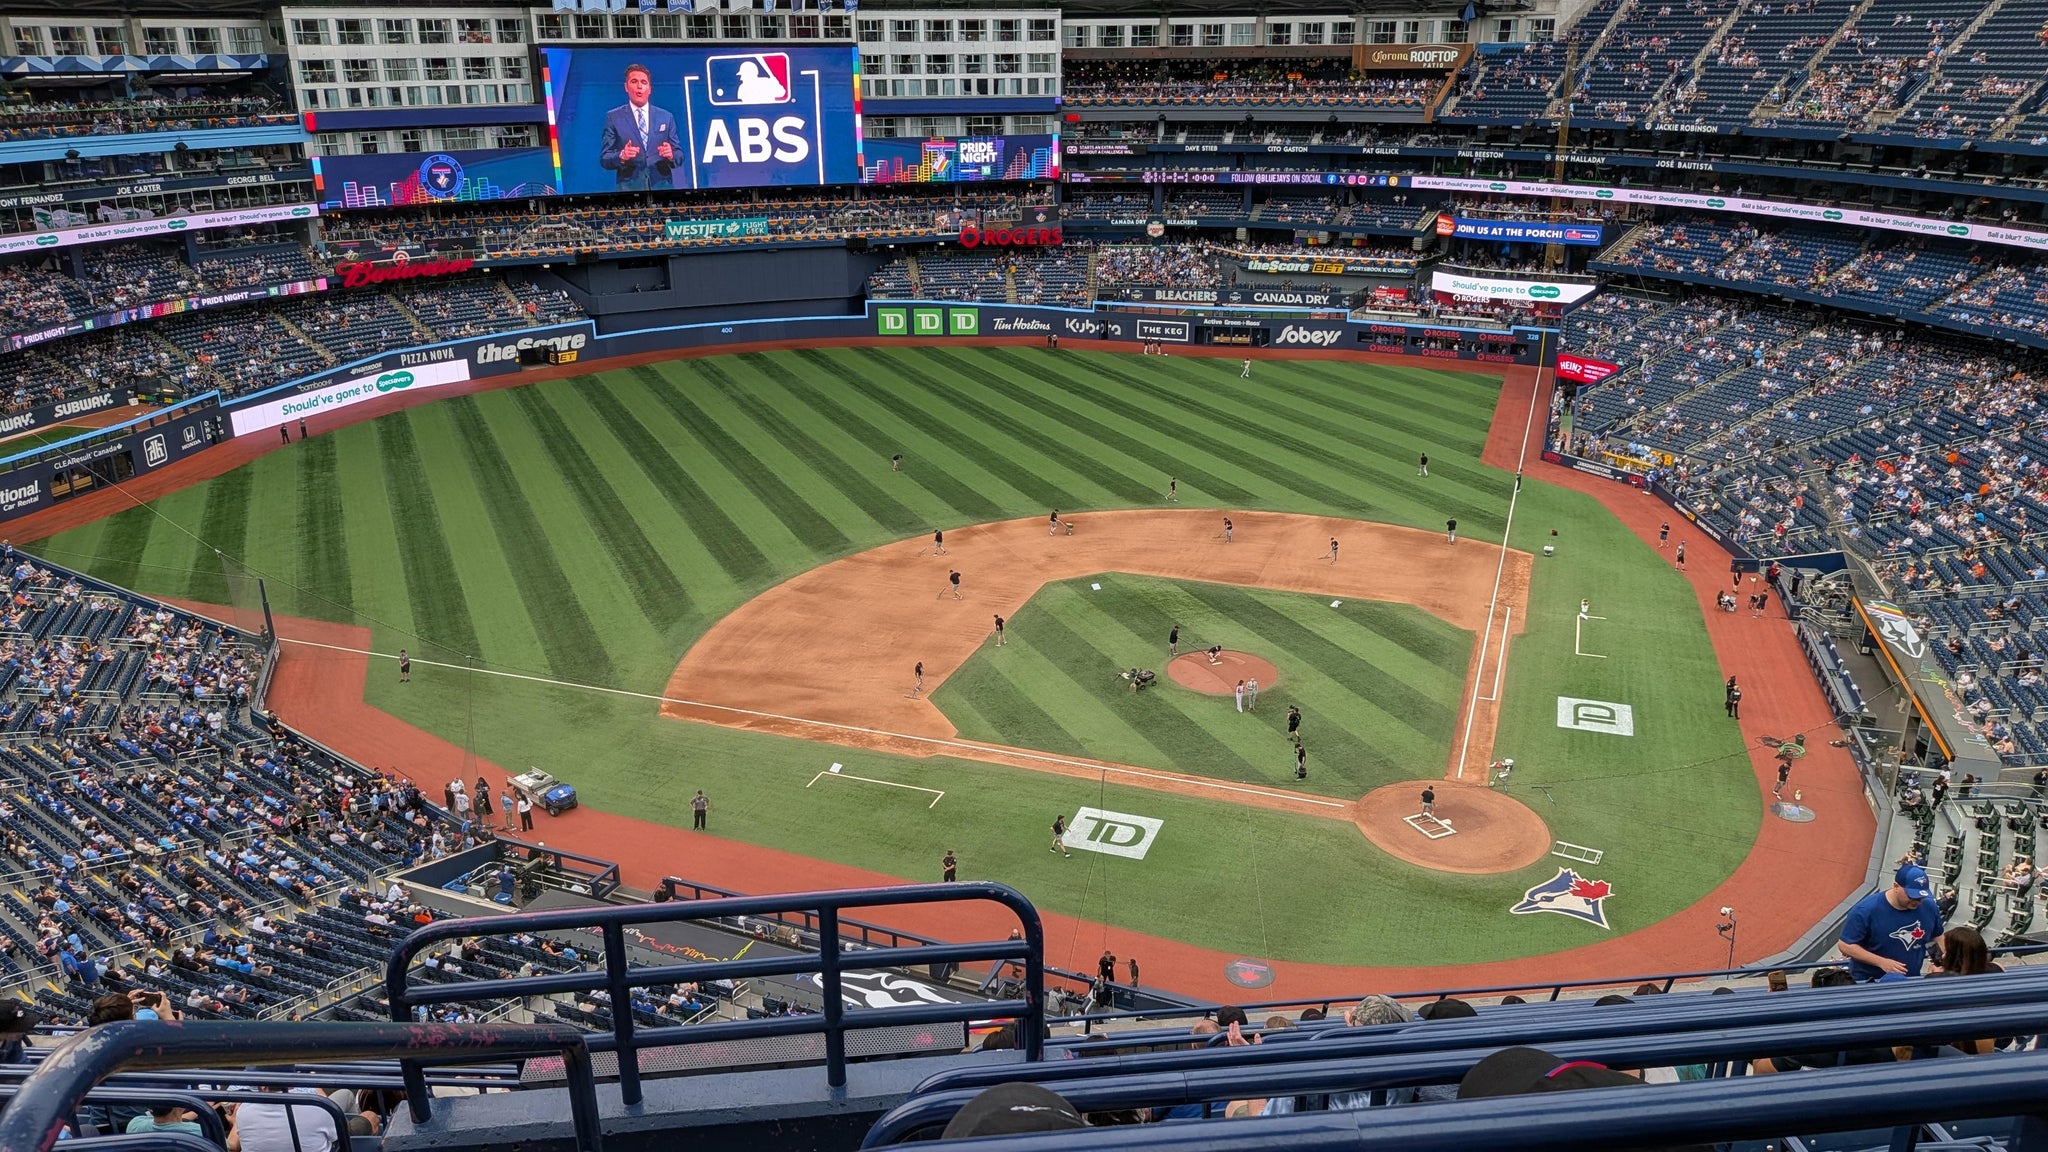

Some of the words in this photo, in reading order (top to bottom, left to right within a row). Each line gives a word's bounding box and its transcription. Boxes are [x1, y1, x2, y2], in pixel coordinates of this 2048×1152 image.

[1371, 50, 1408, 64] Corona
[1410, 51, 1458, 62] ROOFTOP
[1655, 123, 1678, 132] JACKIE
[1680, 124, 1717, 133] ROBINSON
[702, 116, 809, 164] ABS
[960, 142, 994, 153] PRIDE
[960, 152, 998, 163] NIGHT
[1458, 150, 1473, 158] PAUL
[1475, 151, 1503, 159] BEESTON
[1555, 154, 1569, 162] ROY
[1570, 156, 1606, 164] HALLADAY
[1656, 159, 1674, 168] JOSÉ
[1677, 161, 1713, 171] BAUTISTA
[227, 175, 257, 185] GEORGE
[259, 174, 275, 182] BELL
[1232, 174, 1255, 183] FOLLOW
[1255, 174, 1290, 183] @BLUEJAYS
[1292, 175, 1300, 183] ON
[1301, 175, 1322, 183] SOCIAL
[117, 187, 131, 195] JOE
[134, 184, 162, 193] CARTER
[0, 199, 17, 208] ONY
[21, 194, 64, 205] FERNANDEZ
[1658, 195, 1683, 203] Should've
[239, 212, 267, 220] Should've
[1772, 206, 1798, 214] Should've
[1800, 209, 1813, 217] gone
[668, 224, 725, 237] WESTJET
[1892, 219, 1920, 229] Should've
[1921, 223, 1937, 232] gone
[78, 232, 89, 240] Ball
[114, 226, 142, 235] Should've
[144, 225, 158, 233] gone
[985, 228, 1062, 246] ROGERS
[1457, 225, 1475, 234] JOIN
[1477, 227, 1488, 235] US
[1491, 228, 1503, 236] AT
[1506, 228, 1523, 236] THE
[1526, 229, 1563, 239] PORCH!
[2004, 233, 2022, 241] blur?
[8, 240, 26, 249] gone
[336, 255, 474, 288] Budweiser
[1248, 260, 1309, 272] theScore
[1313, 263, 1343, 273] BET
[1452, 280, 1489, 291] Should've
[1491, 284, 1513, 294] gone
[1516, 286, 1526, 294] to
[201, 293, 224, 306] PRIDE
[224, 292, 249, 302] NIGHT
[1155, 290, 1217, 301] BLEACHERS
[1254, 292, 1306, 304] CANADA
[1461, 295, 1490, 304] ROGERS
[881, 313, 905, 330] TD
[916, 313, 940, 330] TD
[953, 313, 976, 330] TD
[993, 317, 1012, 330] Tim
[1013, 317, 1051, 331] Hortons
[24, 332, 44, 344] PRIDE
[44, 327, 66, 339] NIGHT
[1276, 324, 1342, 346] Sobeys
[1378, 326, 1405, 334] ROGERS
[1431, 329, 1460, 338] ROGERS
[1488, 334, 1516, 343] ROGERS
[1527, 333, 1539, 341] 328
[1376, 344, 1404, 353] ROGERS
[1429, 349, 1458, 358] ROGERS
[400, 352, 428, 366] PIZZA
[430, 347, 454, 361] NOVA
[1485, 354, 1514, 363] ROGERS
[1560, 361, 1582, 374] HEINZ
[282, 395, 333, 415] Should've
[335, 386, 361, 403] gone
[362, 383, 374, 393] to
[378, 374, 411, 388] Specsavers
[54, 393, 114, 418] SUBWAY
[0, 412, 35, 432] WAY
[182, 439, 201, 451] HONDA
[54, 453, 91, 470] CLEAResult
[94, 446, 118, 457] Canada
[18, 496, 39, 507] Rental
[1573, 703, 1616, 725] TD
[1084, 815, 1146, 847] TD
